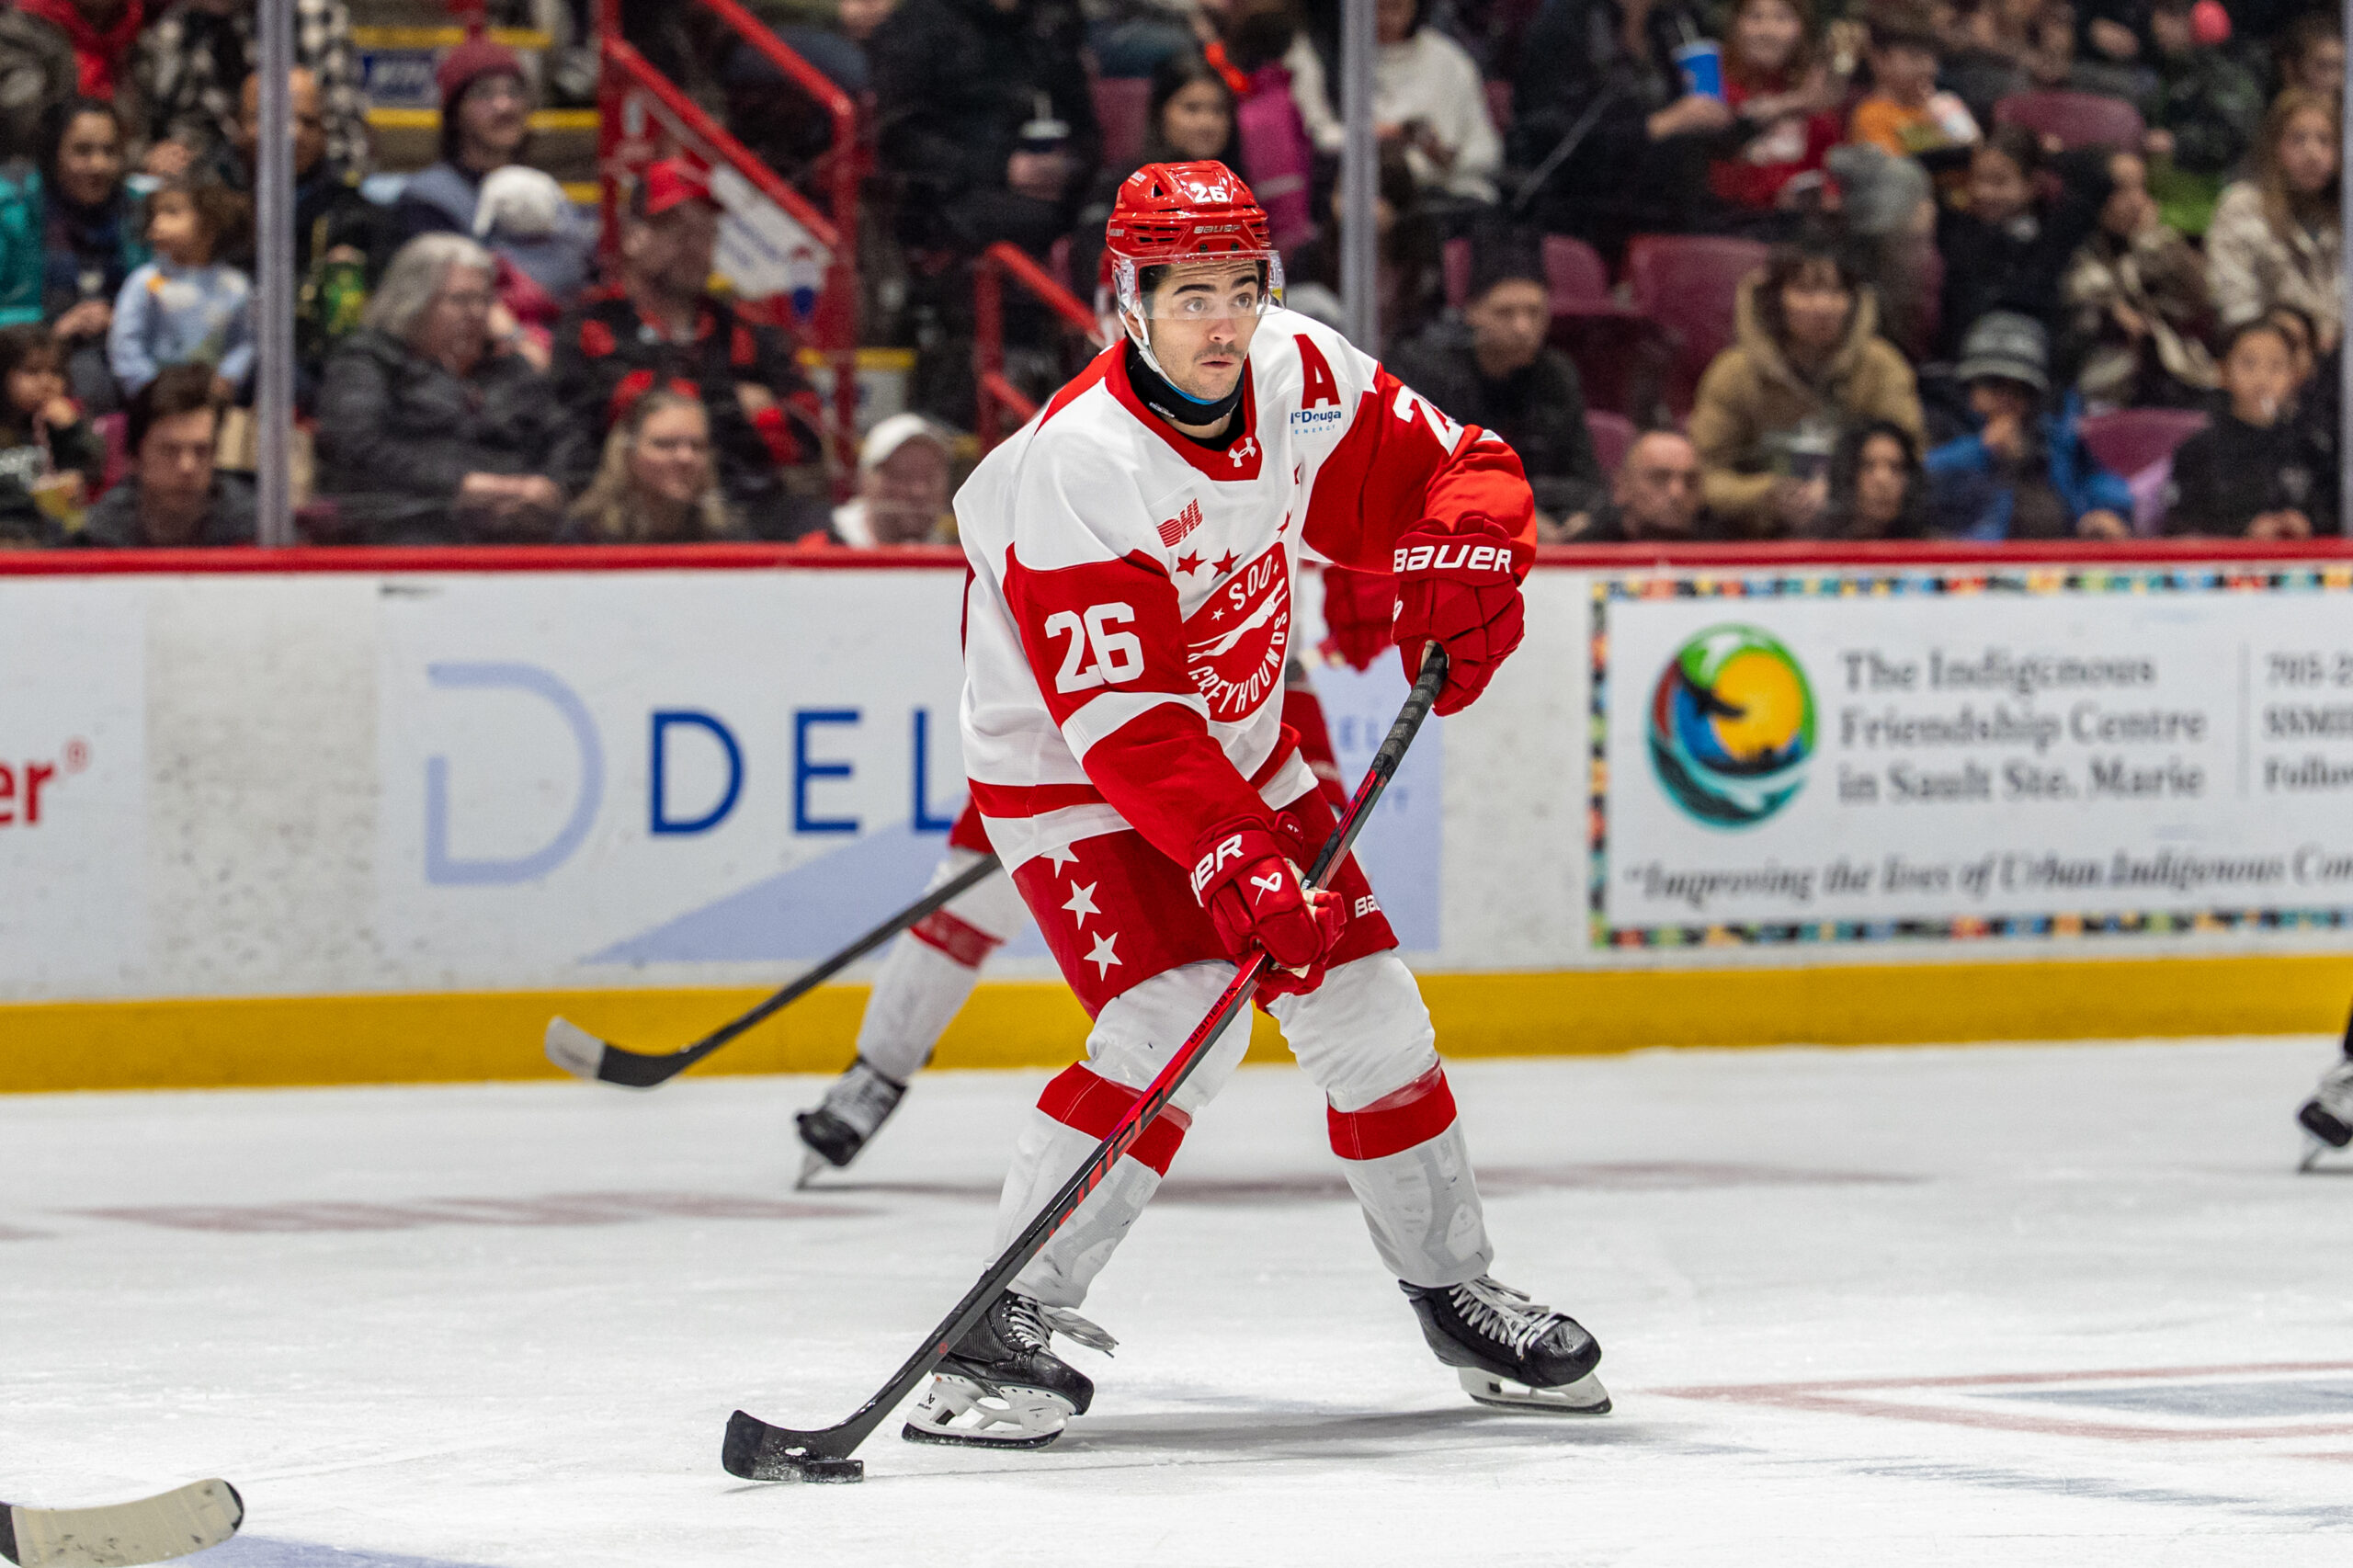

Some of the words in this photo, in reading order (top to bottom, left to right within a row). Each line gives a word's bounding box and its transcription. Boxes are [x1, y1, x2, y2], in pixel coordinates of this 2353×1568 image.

[1194, 183, 1228, 204] 26
[1293, 334, 1341, 410] A
[1228, 553, 1273, 610] SOO
[1044, 601, 1144, 694] 26
[1188, 611, 1288, 713] GREYHOUNDS
[1841, 649, 1917, 687] The
[1931, 646, 2155, 696] Indigenous
[1840, 706, 2061, 754] Friendship
[2070, 700, 2204, 743] Centre
[2086, 756, 2203, 798] Marie
